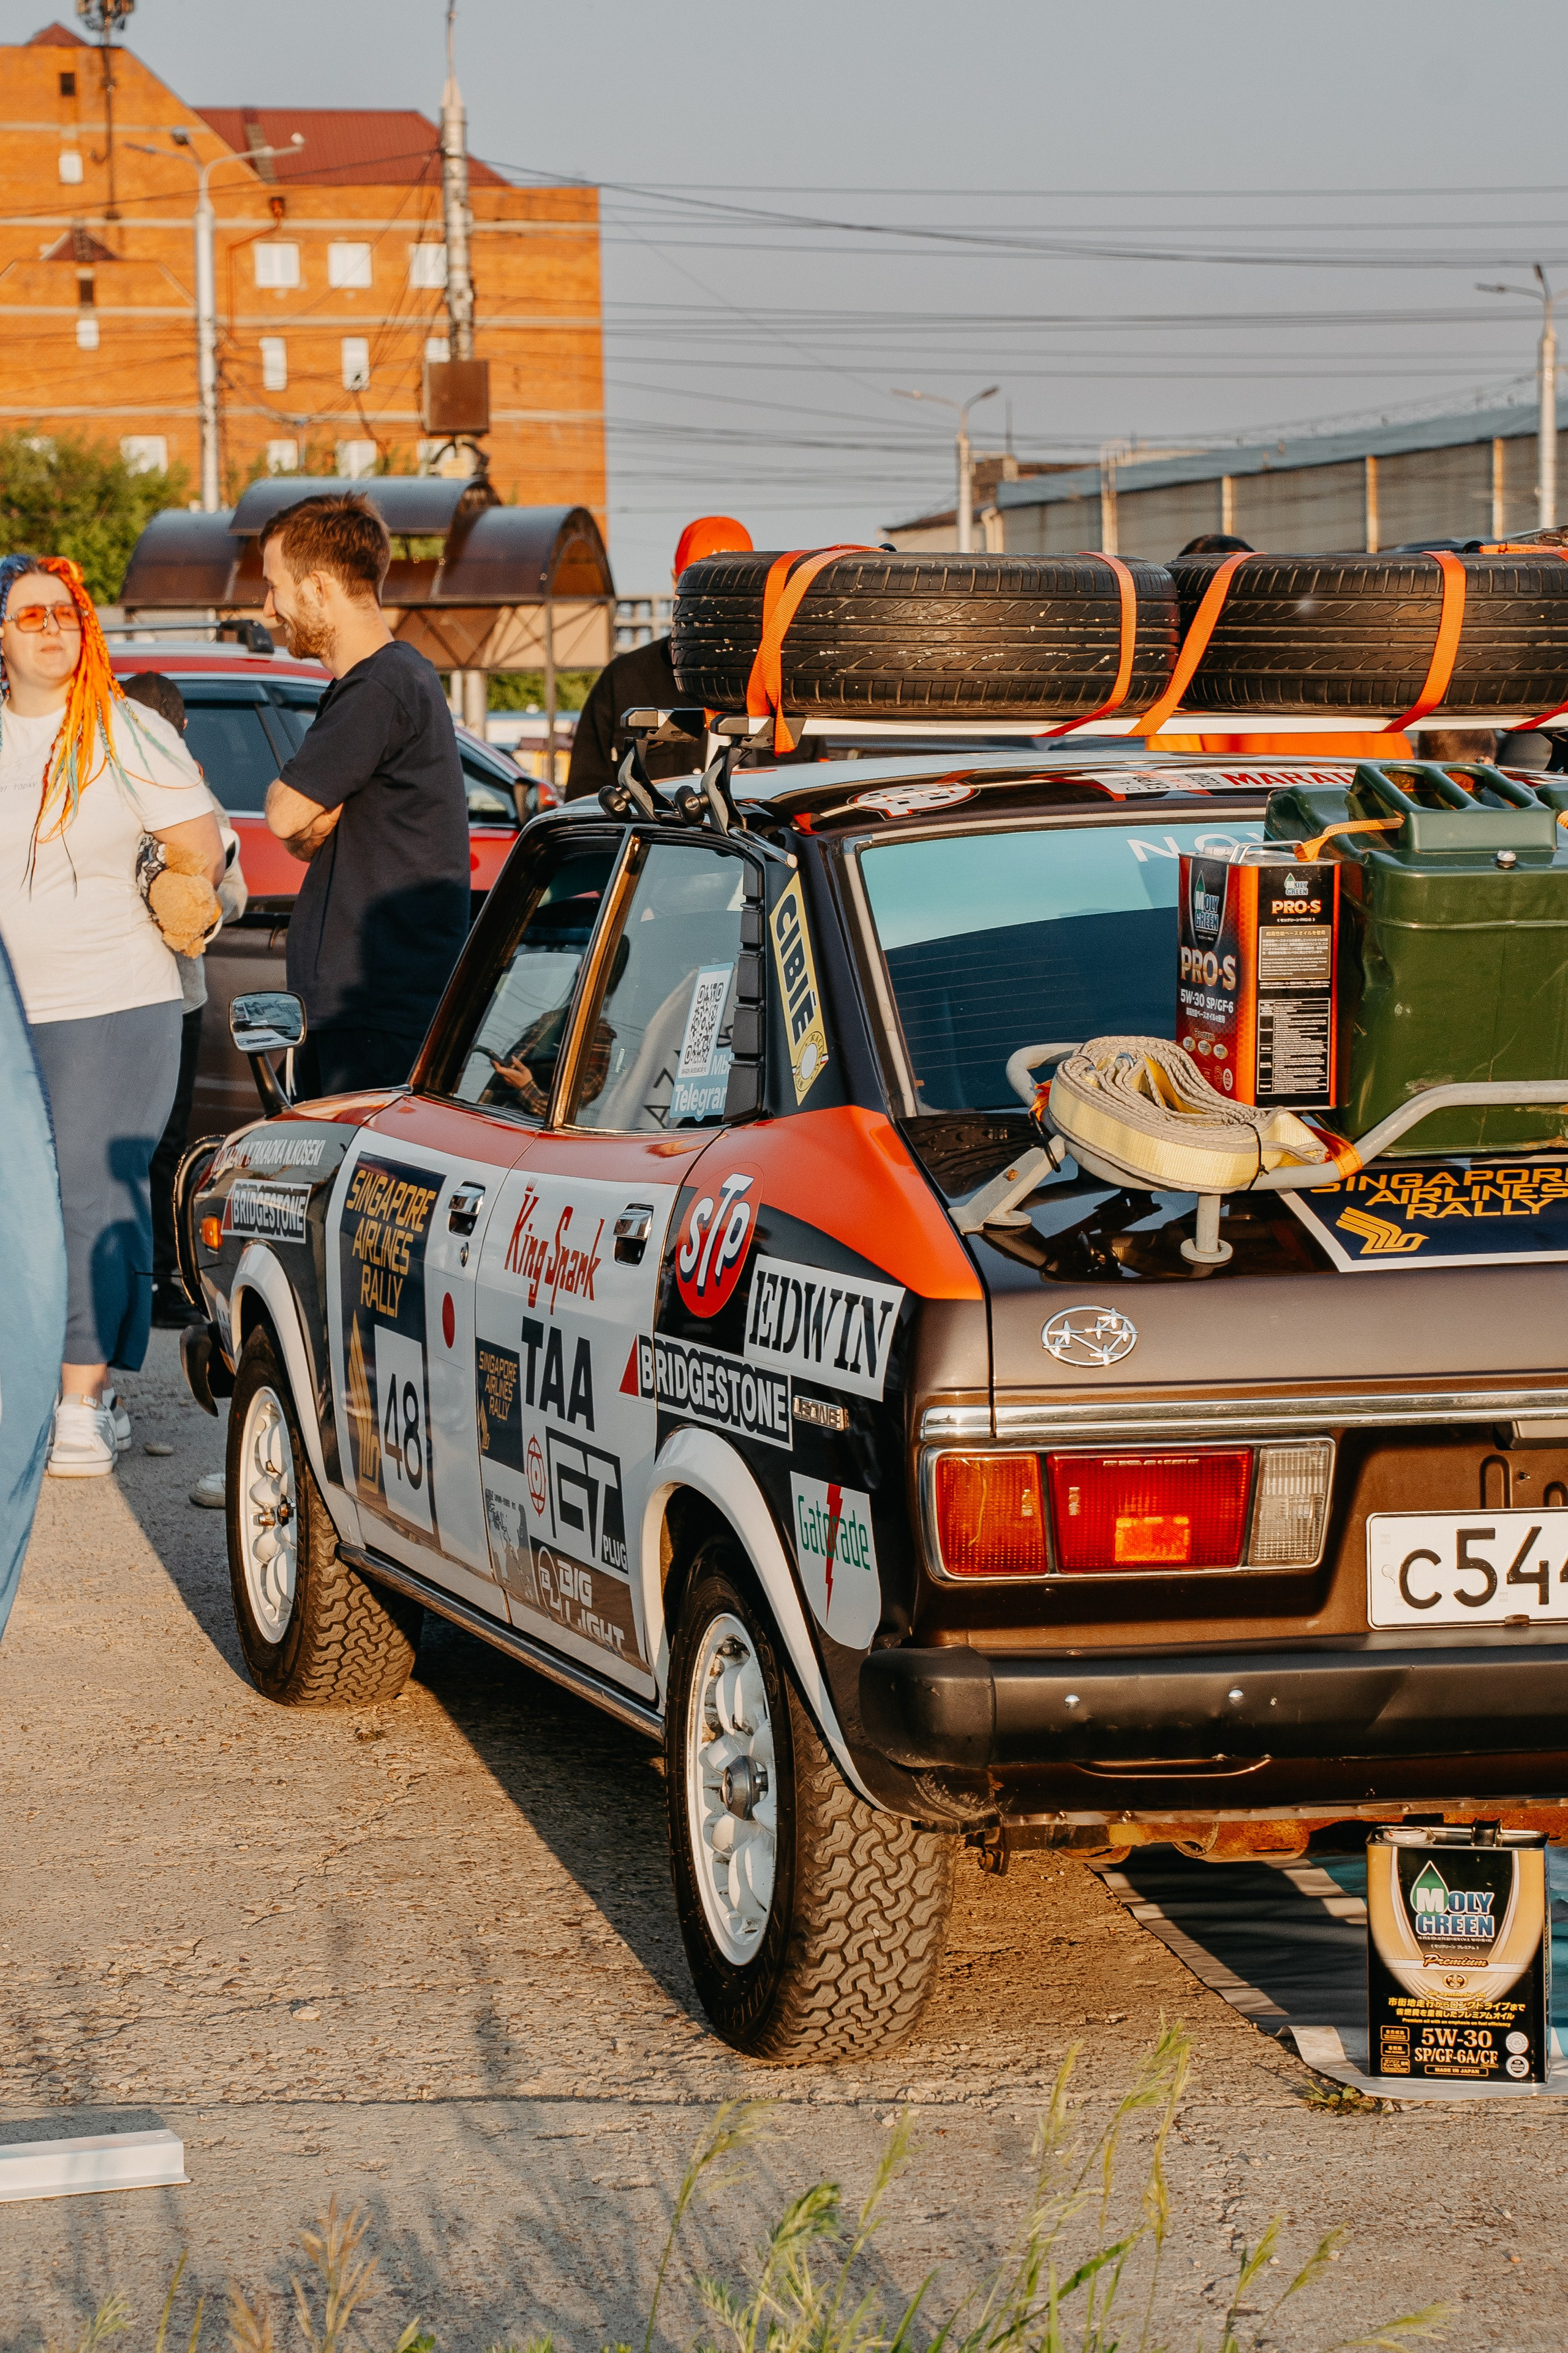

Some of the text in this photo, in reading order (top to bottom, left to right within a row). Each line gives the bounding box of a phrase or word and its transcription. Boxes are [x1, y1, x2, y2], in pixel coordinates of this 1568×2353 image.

[1195, 890, 1219, 913] MOLY
[1194, 910, 1219, 931] GREEN
[1310, 1168, 1568, 1193] SINGAPOR
[1365, 1183, 1568, 1206] AIRLINES
[233, 1190, 306, 1231] BRIDGESTONE
[346, 1169, 437, 1233] SINGAPORE
[1406, 1198, 1554, 1219] RALLY
[352, 1217, 413, 1275] AIRLINES
[504, 1192, 549, 1309] King
[361, 1264, 403, 1318] RALLY
[748, 1269, 895, 1380] EDWIN
[479, 1351, 518, 1383] SINGAPORE
[522, 1315, 596, 1432] TAA
[484, 1374, 513, 1402] AIRLINES
[639, 1346, 788, 1433] BRIDGESTONE
[489, 1396, 510, 1421] RALLY
[793, 1396, 842, 1429] LEONE
[385, 1373, 423, 1490] 48
[797, 1496, 871, 1571] Gatorade
[603, 1534, 628, 1571] PLUG
[557, 1559, 592, 1609] BIG
[1416, 1887, 1494, 1914] MOLY
[1416, 1914, 1494, 1938] GREEN
[1423, 1954, 1488, 1967] Premium
[1421, 2028, 1492, 2048] 5W-30
[1415, 2048, 1498, 2064] SP/GF-6A/CF
